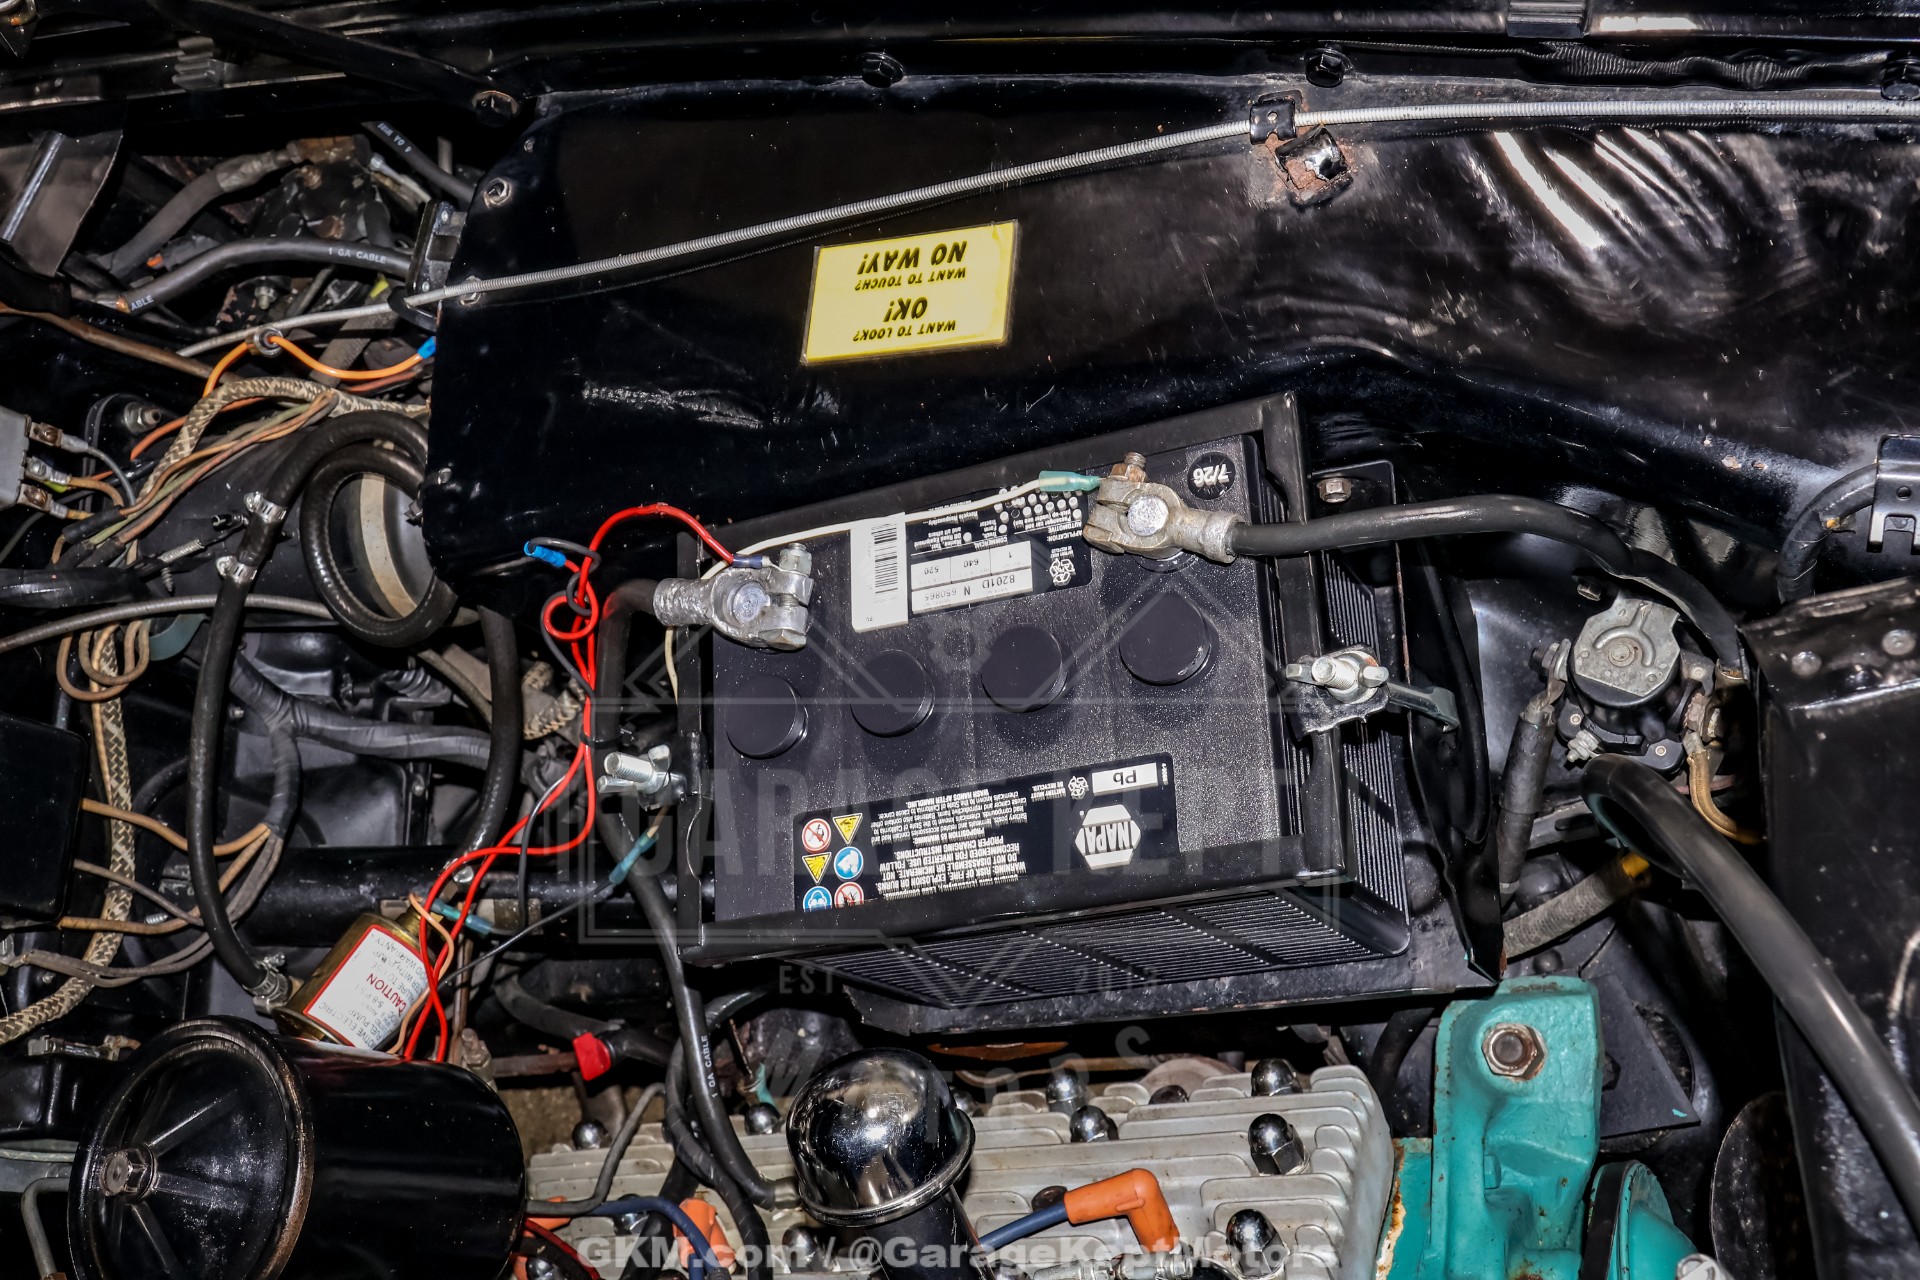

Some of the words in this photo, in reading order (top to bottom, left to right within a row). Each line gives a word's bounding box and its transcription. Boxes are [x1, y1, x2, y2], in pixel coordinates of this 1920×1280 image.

[337, 248, 351, 257] GA
[355, 250, 386, 264] CABLE
[928, 240, 969, 265] NO
[854, 246, 921, 274] WAY!
[906, 272, 923, 284] TO
[926, 267, 966, 282] WANT
[853, 275, 902, 291] TOUCH?
[880, 295, 929, 322] OK!
[896, 324, 913, 337] TO
[915, 319, 956, 334] WANT
[851, 326, 893, 342] LOOK?
[1193, 463, 1229, 484] 7/26
[1047, 521, 1081, 532] AUTOMOTIVE
[1046, 529, 1082, 541] APPLICATION:
[962, 557, 978, 567] 640
[923, 565, 938, 574] 520
[981, 574, 1015, 588] 8201D
[962, 586, 970, 596] N
[1111, 769, 1137, 785] Pb
[953, 791, 971, 800] HANDS
[972, 788, 988, 797] WASH
[993, 791, 1018, 801] chemicals
[1030, 790, 1044, 798] MUST
[1044, 787, 1065, 795] BATTERY
[905, 797, 934, 808] HANDLING.
[935, 794, 952, 803] AFTER
[975, 795, 992, 804] known
[993, 799, 1010, 807] cancer
[916, 804, 939, 813] California
[951, 803, 982, 815] reproductive
[884, 817, 902, 826] contain
[914, 812, 935, 821] Batteries
[937, 816, 954, 824] known
[955, 812, 980, 821] chemicals
[870, 820, 883, 828] other
[879, 824, 902, 834] California
[909, 821, 921, 829] State
[891, 831, 910, 839] contain
[911, 826, 939, 836] accessories
[948, 827, 984, 838] PROPOSITION
[1084, 821, 1130, 853] NAPA
[912, 834, 939, 844] WARNING:
[977, 835, 1004, 847] PROPER
[893, 844, 941, 859] INSTRUCTIONS.
[942, 839, 976, 852] CHARGING
[969, 842, 1019, 858] RECOMMENDED
[922, 852, 953, 865] INVERTED
[954, 850, 967, 860] FOR
[992, 854, 1005, 864] NOT
[1007, 852, 1016, 862] DO
[879, 859, 905, 872] FOLLOW
[936, 863, 945, 872] OR
[946, 856, 991, 871] DISASSEMBLE
[992, 861, 1025, 874] WARNING:
[965, 868, 974, 878] OF
[975, 866, 990, 876] RISK
[875, 879, 899, 891] BURNS.
[900, 878, 909, 887] OR
[910, 872, 946, 886] EXPLOSION
[376, 934, 417, 969] WARRANTY
[394, 963, 414, 983] WITH
[365, 972, 407, 1012] CAUTION
[316, 1000, 358, 1032] ELECTRIC
[367, 1023, 384, 1040] FUEL
[701, 1034, 711, 1067] CABLE
[708, 1072, 716, 1087] GA
